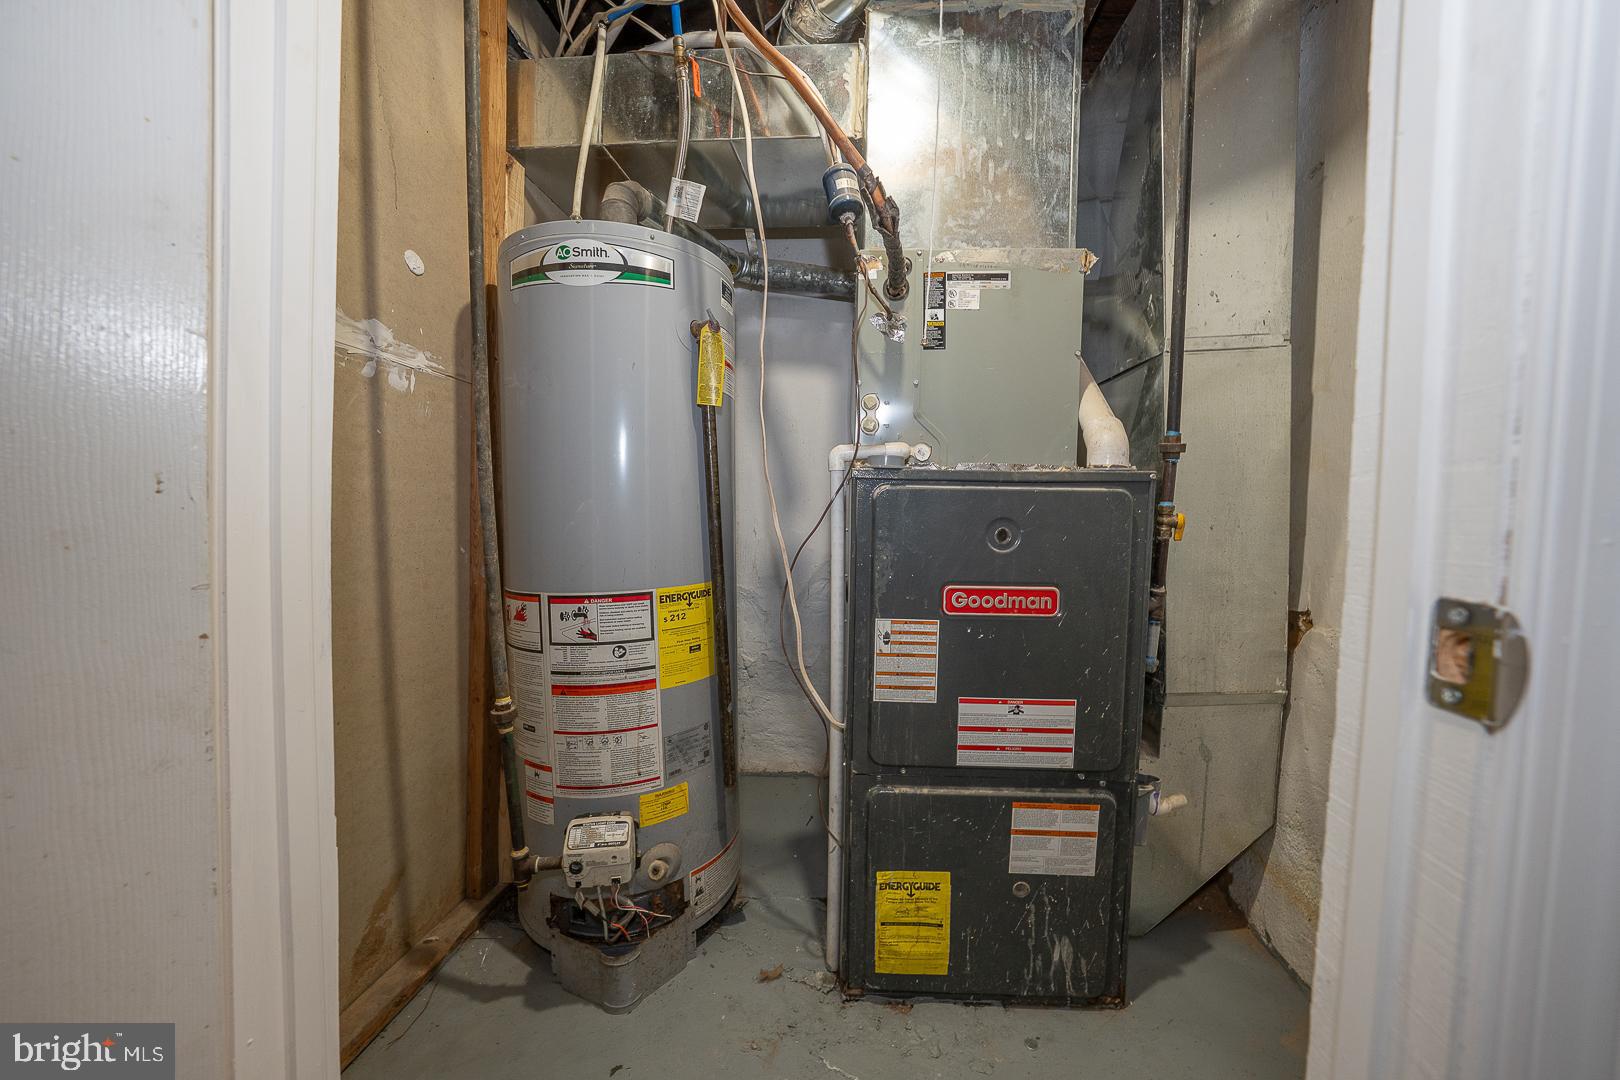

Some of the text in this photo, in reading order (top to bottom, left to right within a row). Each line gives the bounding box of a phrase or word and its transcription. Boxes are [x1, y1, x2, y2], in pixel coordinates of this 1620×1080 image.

[590, 597, 613, 605] DANGER
[659, 588, 712, 605] ENERGYGUIDE
[951, 591, 1053, 610] Goodman
[670, 612, 687, 622] 212
[879, 881, 941, 893] ENERGYGUIDE
